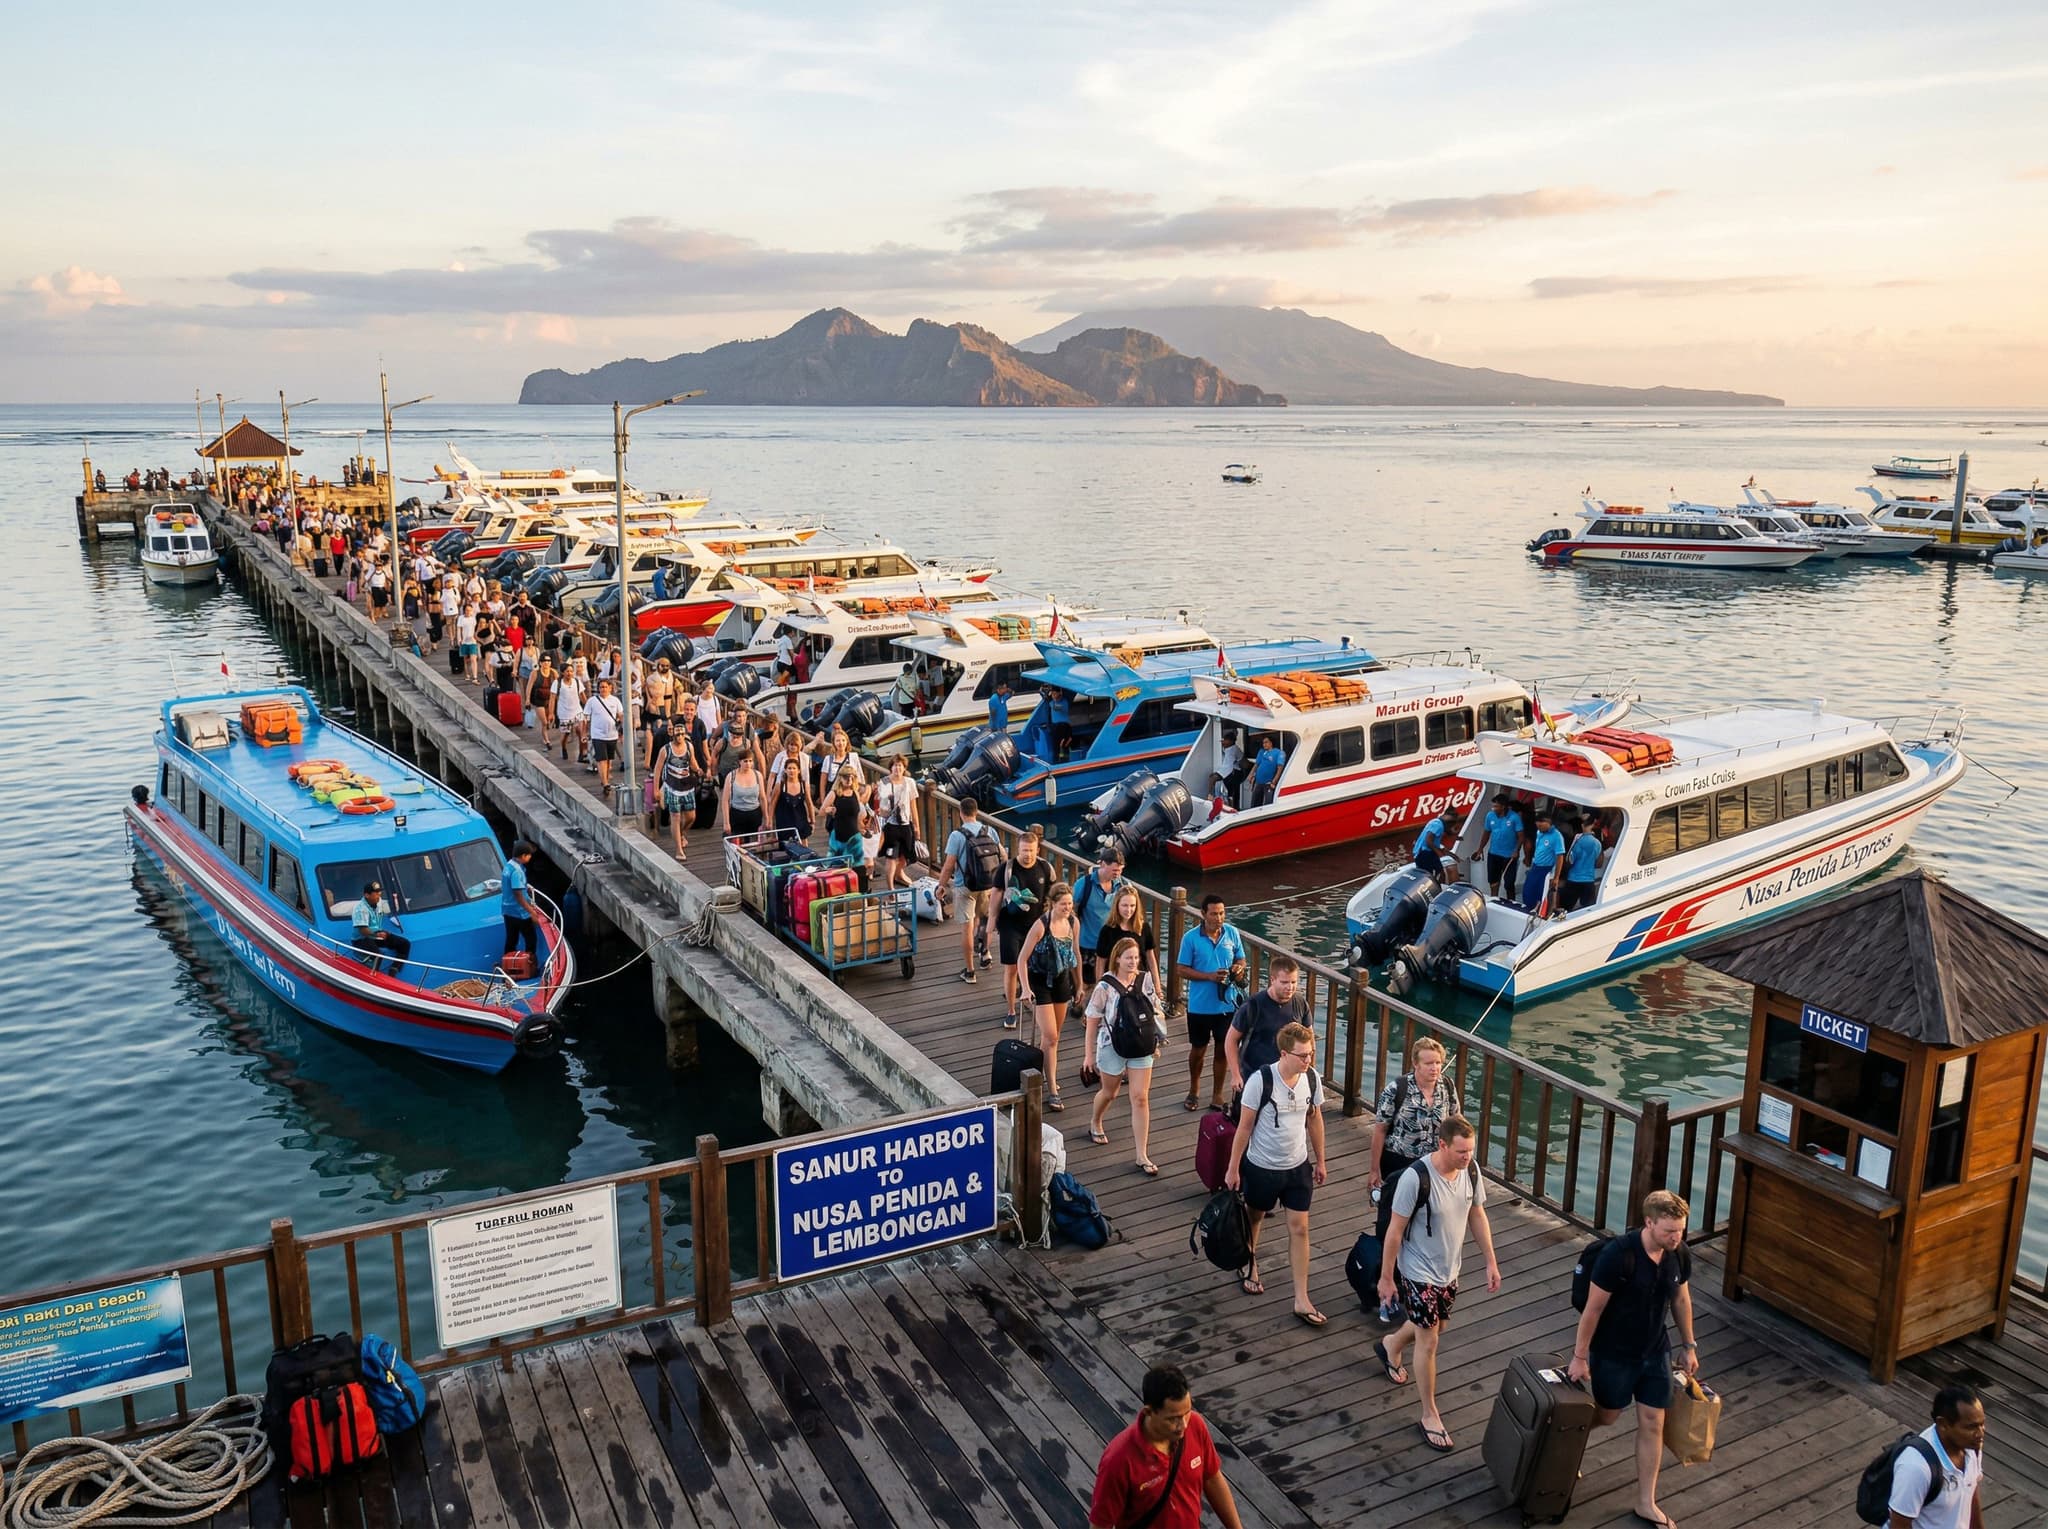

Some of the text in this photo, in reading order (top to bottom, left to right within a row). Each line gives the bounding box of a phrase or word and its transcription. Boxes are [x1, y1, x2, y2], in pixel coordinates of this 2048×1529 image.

[1376, 694, 1464, 718] Maruti Group
[1664, 782, 1691, 799] Crown
[1693, 775, 1710, 790] Fast
[1711, 769, 1737, 786] Cruise
[1370, 799, 1410, 828] Sri
[1739, 832, 1894, 911] Nusa Penida Express
[1807, 1009, 1865, 1044] TICKET
[790, 1123, 985, 1184] SANUR HARBOR
[877, 1168, 904, 1187] TO
[532, 1202, 574, 1219] HOMAN
[793, 1172, 983, 1235] NUSA PENIDA &
[813, 1202, 967, 1259] LEMBONGAN
[98, 1289, 147, 1308] Beach
